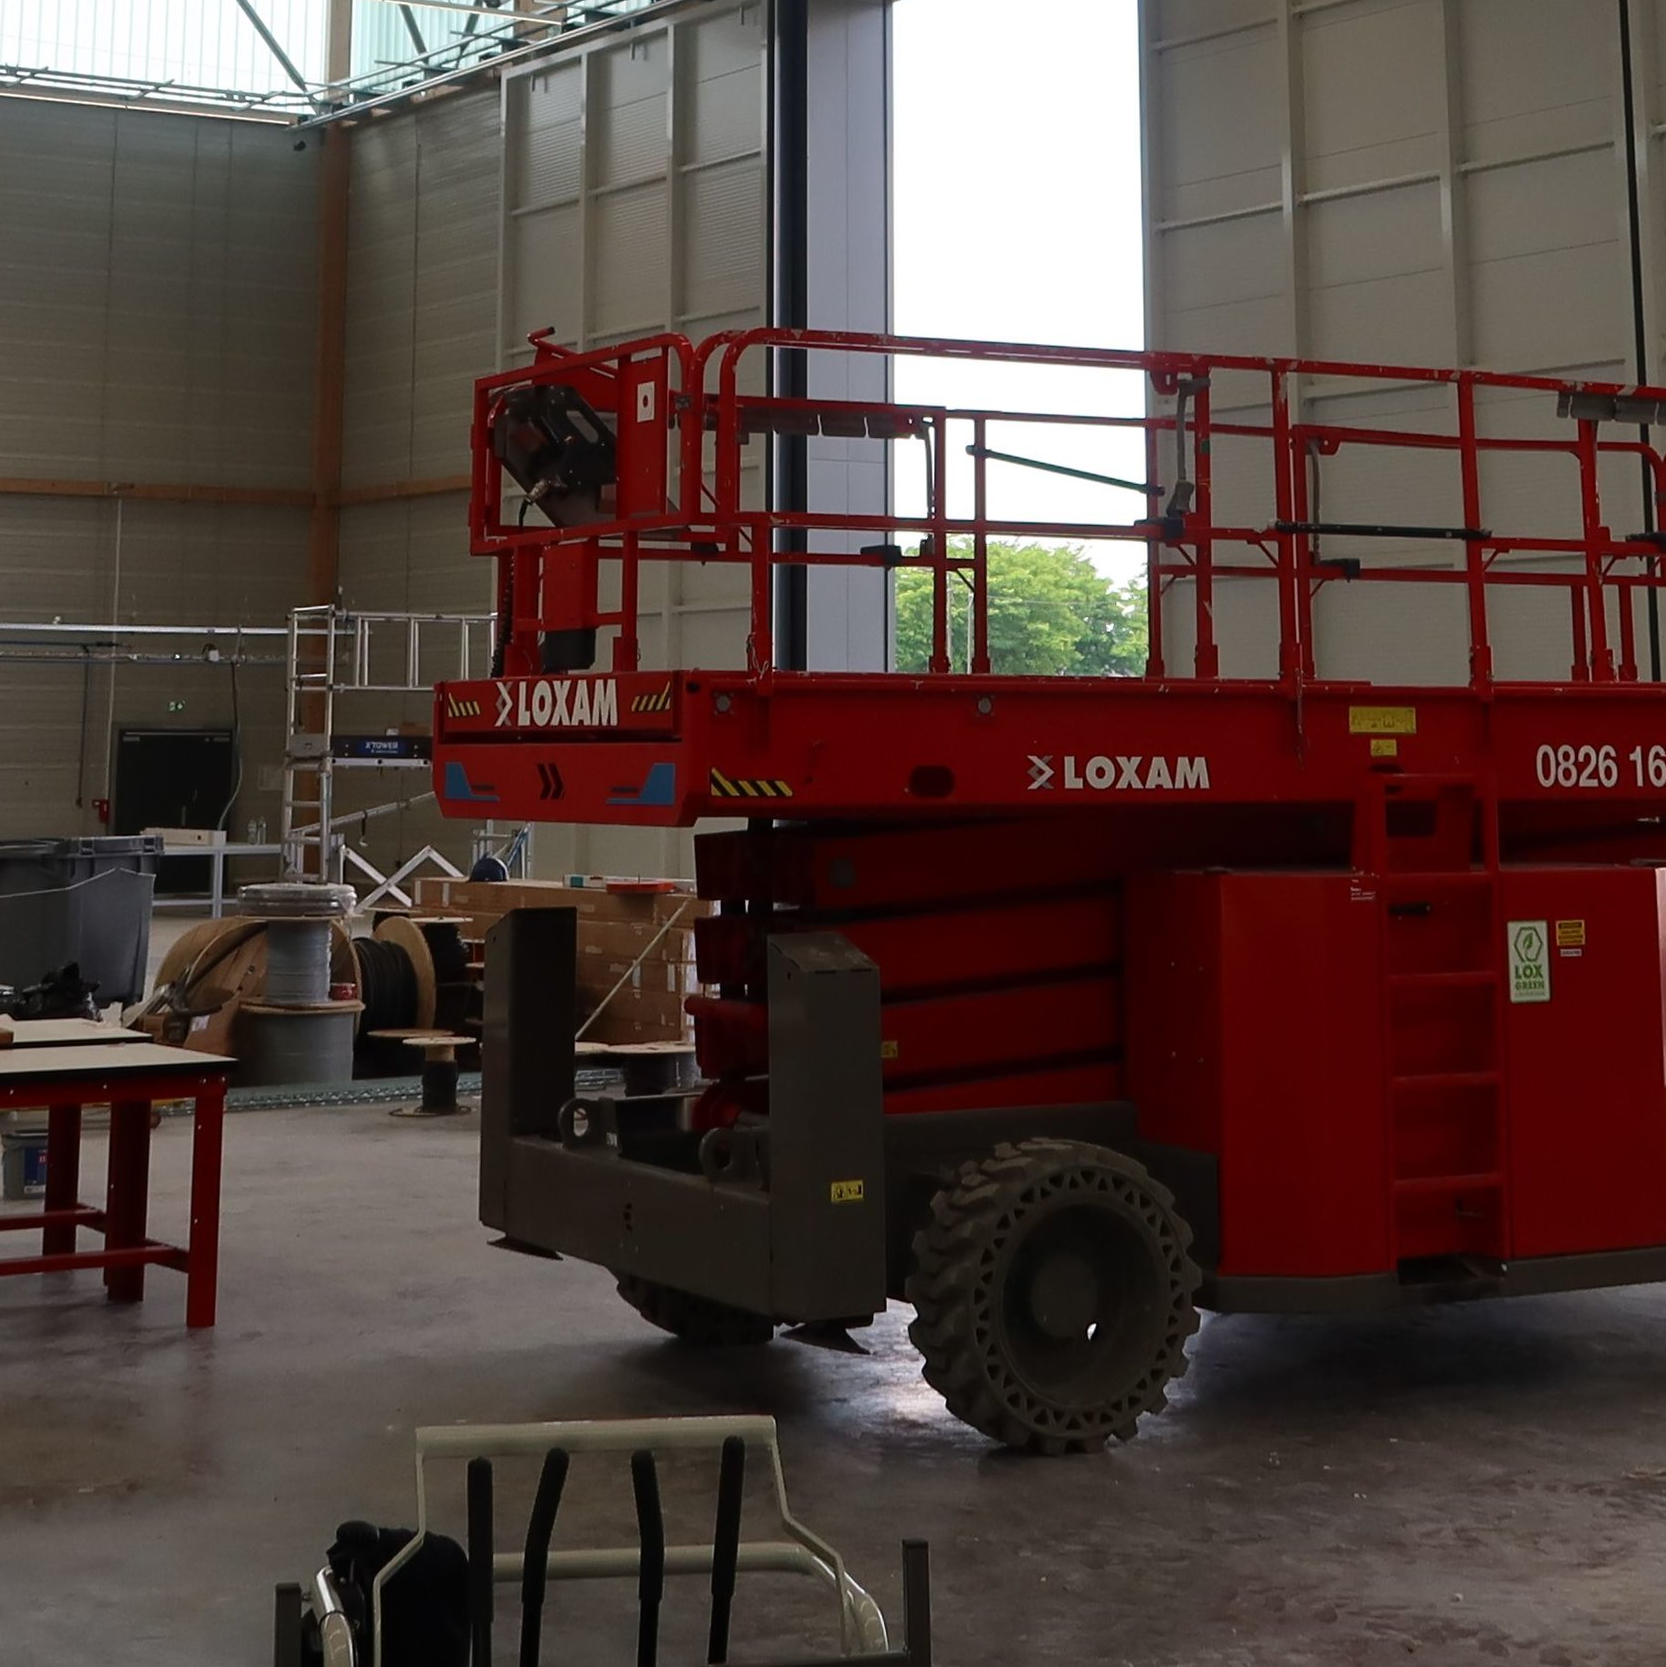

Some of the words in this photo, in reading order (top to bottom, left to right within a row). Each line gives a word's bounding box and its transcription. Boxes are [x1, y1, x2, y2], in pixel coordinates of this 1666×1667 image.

[517, 679, 618, 727] LOXAM
[1064, 755, 1210, 790] LOXAM
[1536, 744, 1618, 788] 0826
[1514, 964, 1544, 979] LOX
[1515, 980, 1545, 990] GREEN
